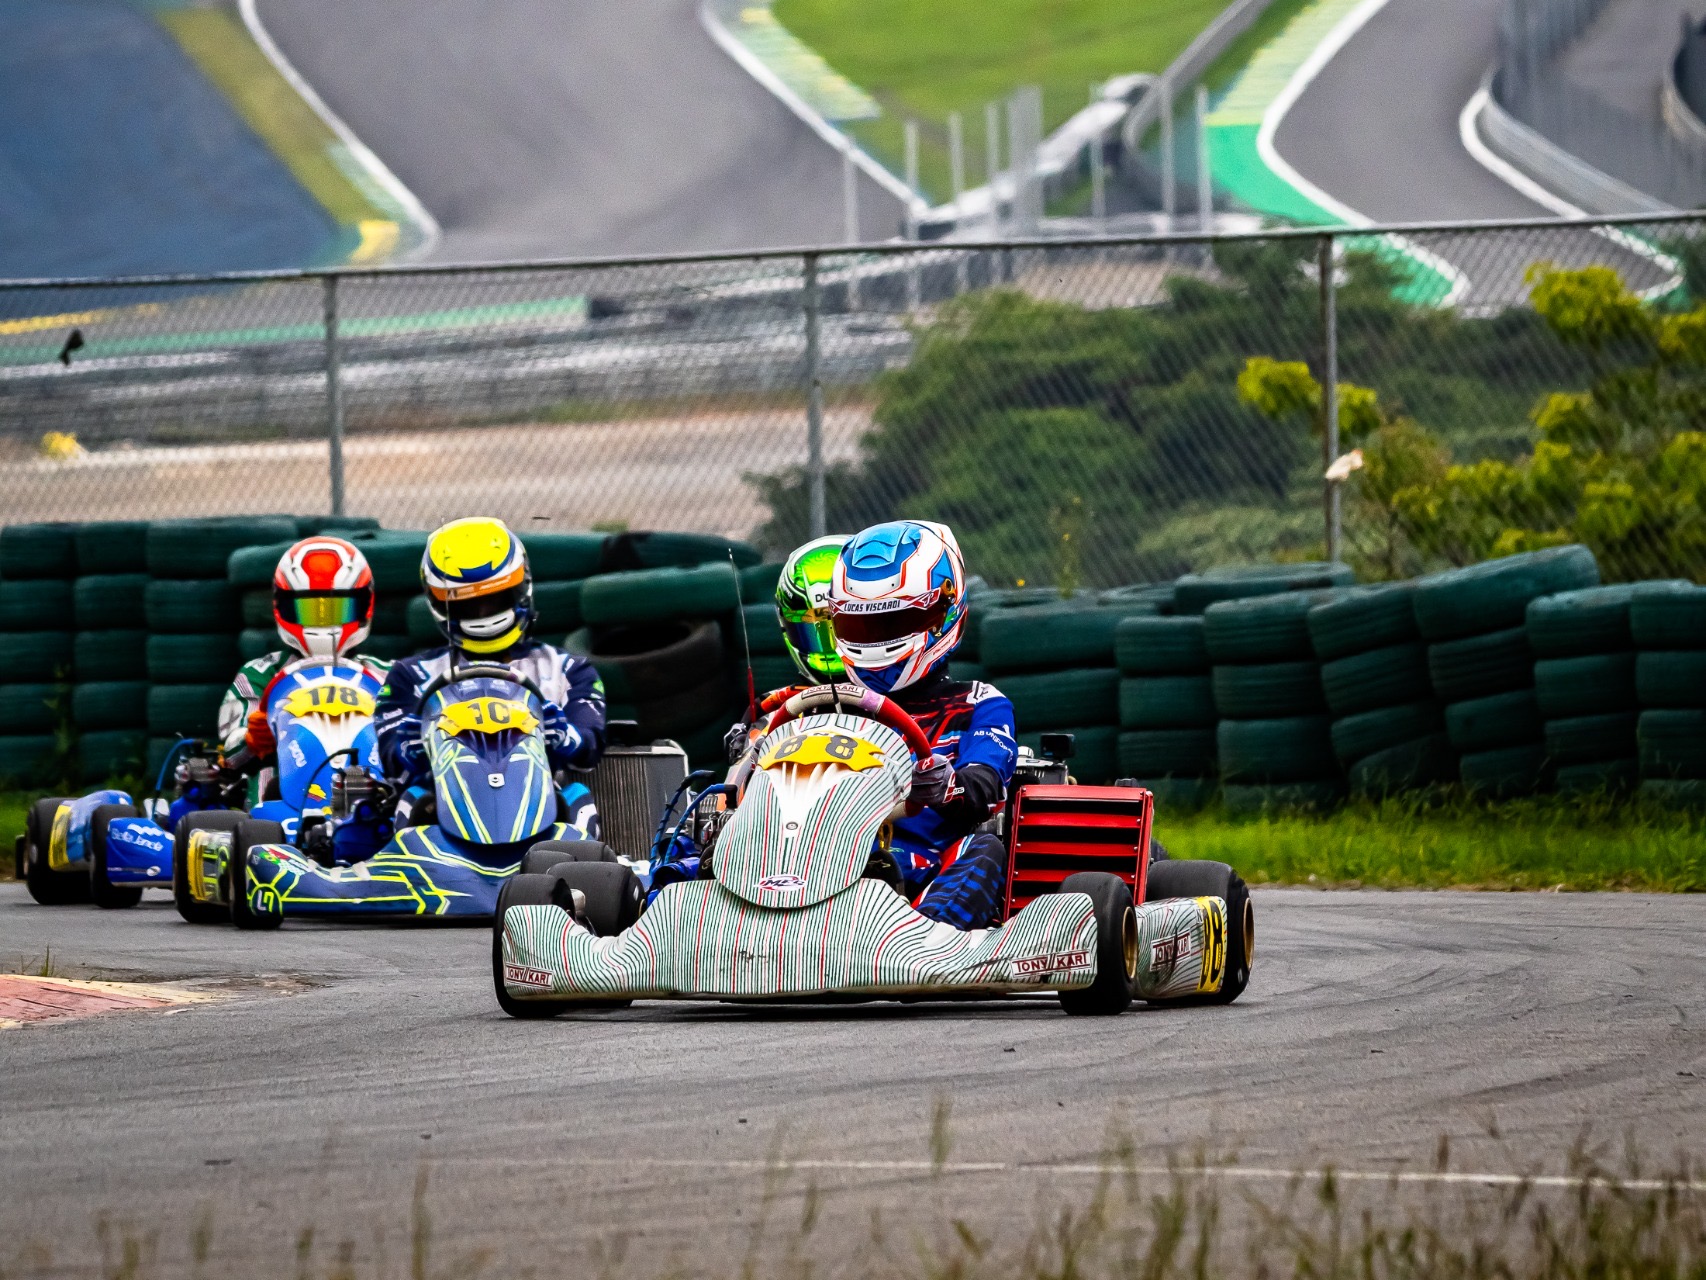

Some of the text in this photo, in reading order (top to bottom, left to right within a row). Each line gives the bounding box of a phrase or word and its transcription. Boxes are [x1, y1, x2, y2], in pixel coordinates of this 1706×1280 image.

[843, 599, 901, 612] LUCAS VISCARDI
[307, 685, 359, 706] 178
[774, 733, 858, 760] 88
[1013, 952, 1090, 973] TONY KART
[1153, 941, 1174, 965] TONY
[528, 971, 551, 985] KART
